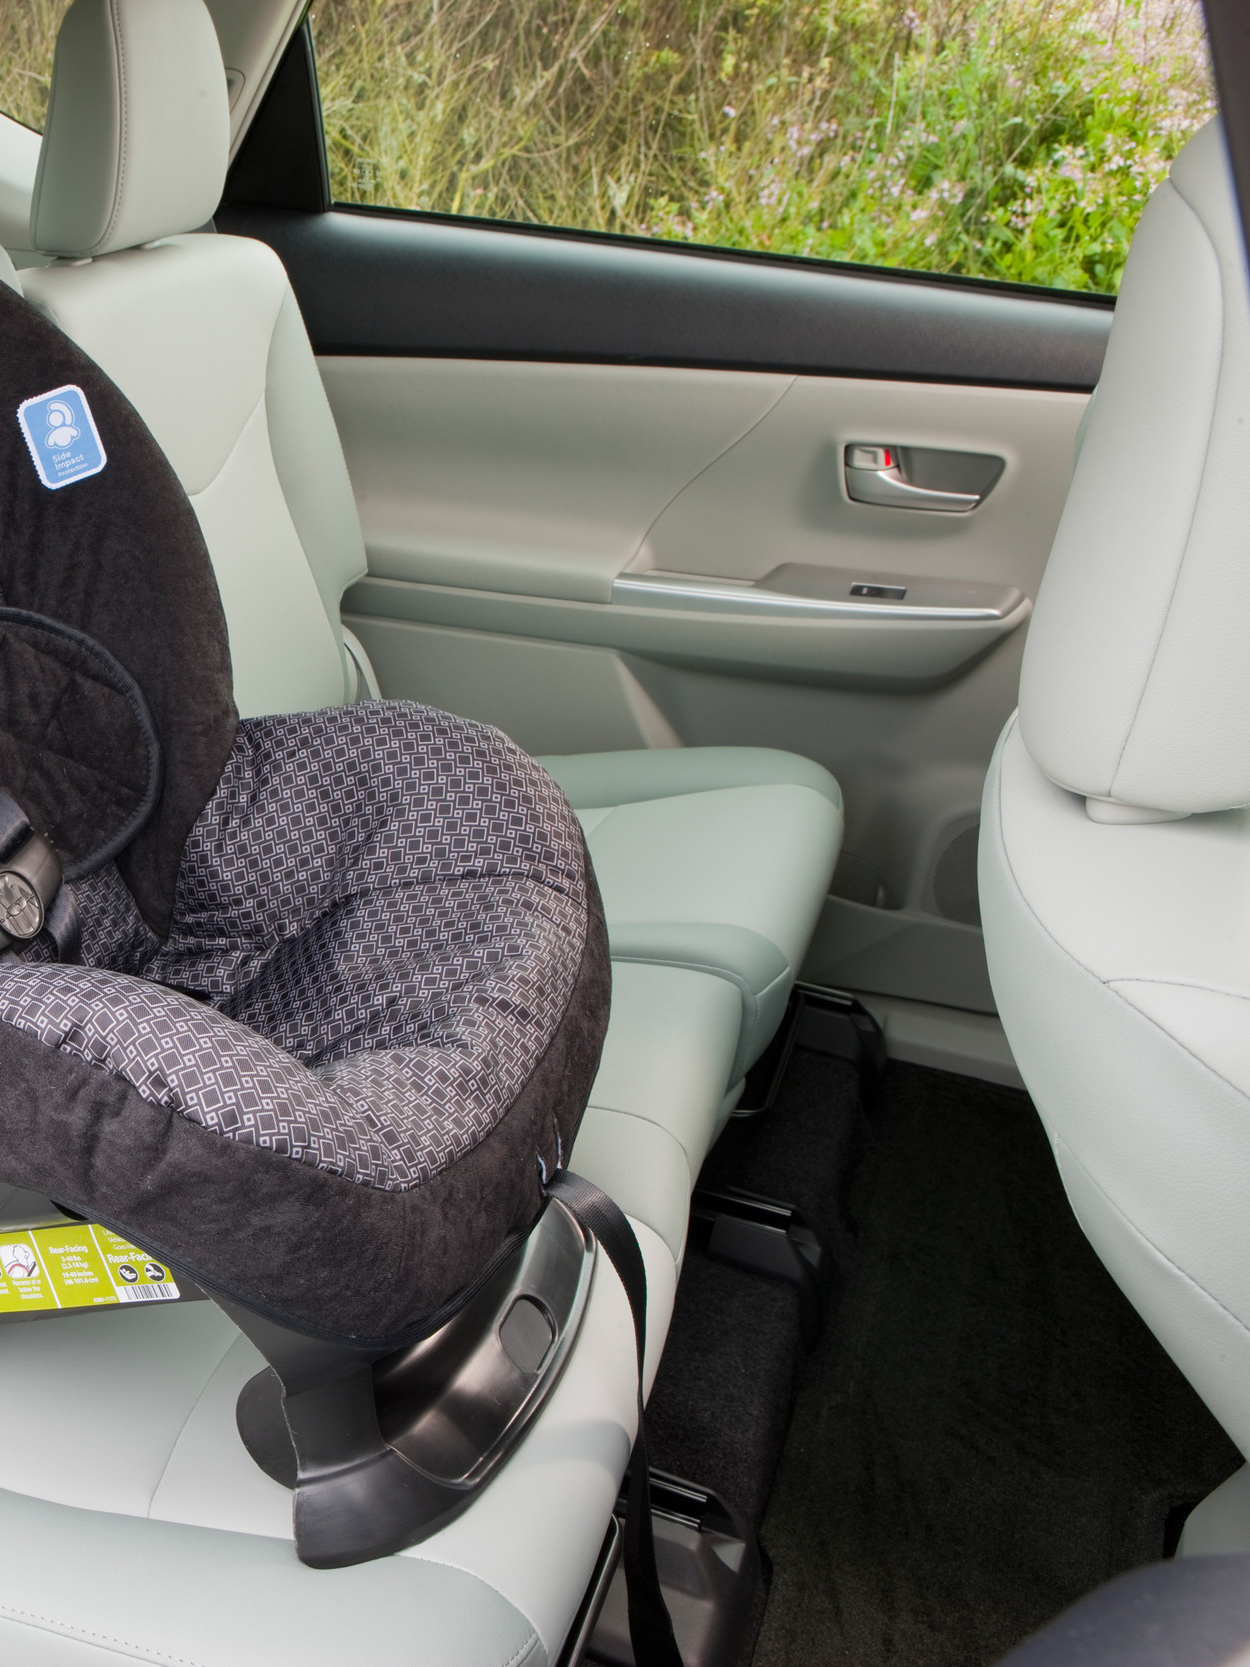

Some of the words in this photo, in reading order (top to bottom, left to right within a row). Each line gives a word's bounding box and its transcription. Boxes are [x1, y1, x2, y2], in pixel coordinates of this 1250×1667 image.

[52, 451, 71, 463] Side
[54, 453, 85, 470] Impact
[58, 463, 88, 477] Protection
[48, 1244, 88, 1254] Rear-Facing
